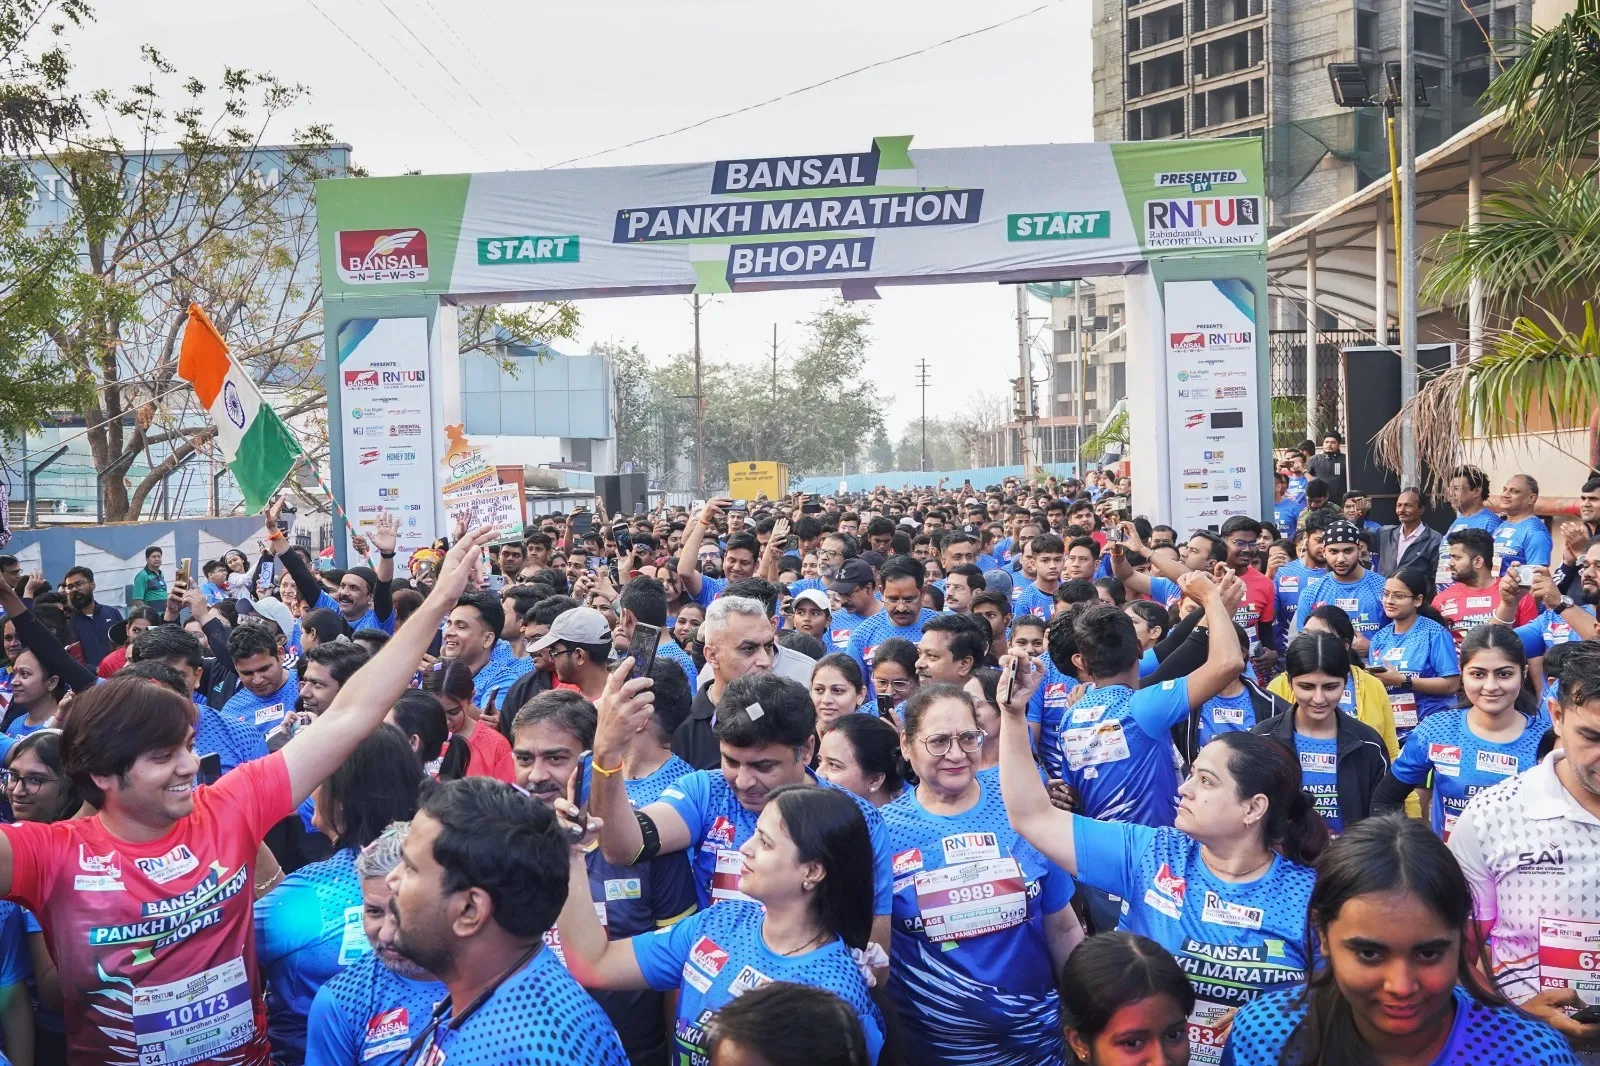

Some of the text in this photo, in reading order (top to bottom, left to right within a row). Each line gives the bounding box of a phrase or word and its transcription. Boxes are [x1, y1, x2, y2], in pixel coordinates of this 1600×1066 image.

[725, 156, 865, 190] BANSAL
[1160, 171, 1238, 184] PRESENTED
[1194, 182, 1208, 192] BY
[627, 192, 968, 239] PANKH MARATHON
[1148, 198, 1236, 229] RNTU
[1016, 213, 1100, 236] START
[1149, 229, 1202, 238] Rabindranath
[1149, 235, 1256, 247] TAGORE UNIVERSITY
[486, 238, 570, 261] START
[349, 255, 422, 271] BANSAL
[732, 243, 866, 275] BHOPAL
[1209, 332, 1243, 344] RNTU
[382, 370, 416, 383] RNTU
[386, 452, 403, 461] HONEY
[404, 452, 416, 461] DEW
[1212, 450, 1224, 459] LIC
[387, 488, 399, 496] LIC
[1301, 753, 1328, 764] RNTU
[1479, 752, 1509, 765] RNTU
[1302, 784, 1338, 794] ANSAL
[945, 835, 985, 851] RNTU
[1516, 849, 1564, 868] SAI
[146, 878, 218, 914] BANSAL
[948, 883, 995, 904] 9989
[925, 916, 943, 926] AGE
[96, 918, 166, 943] PANKH
[954, 928, 977, 939] PANKH
[977, 923, 1012, 936] MARATHON
[1187, 939, 1261, 961] BANSAL
[1544, 978, 1565, 988] AGE
[151, 991, 170, 1001] RNTU
[165, 993, 229, 1027] 10173
[170, 1013, 230, 1037] kirti vardhan singh
[189, 1033, 207, 1044] OPEN
[141, 1044, 162, 1054] AGE
[177, 1053, 204, 1066] PANKH
[204, 1040, 244, 1059] MARATHON
[145, 1054, 162, 1065] 34
